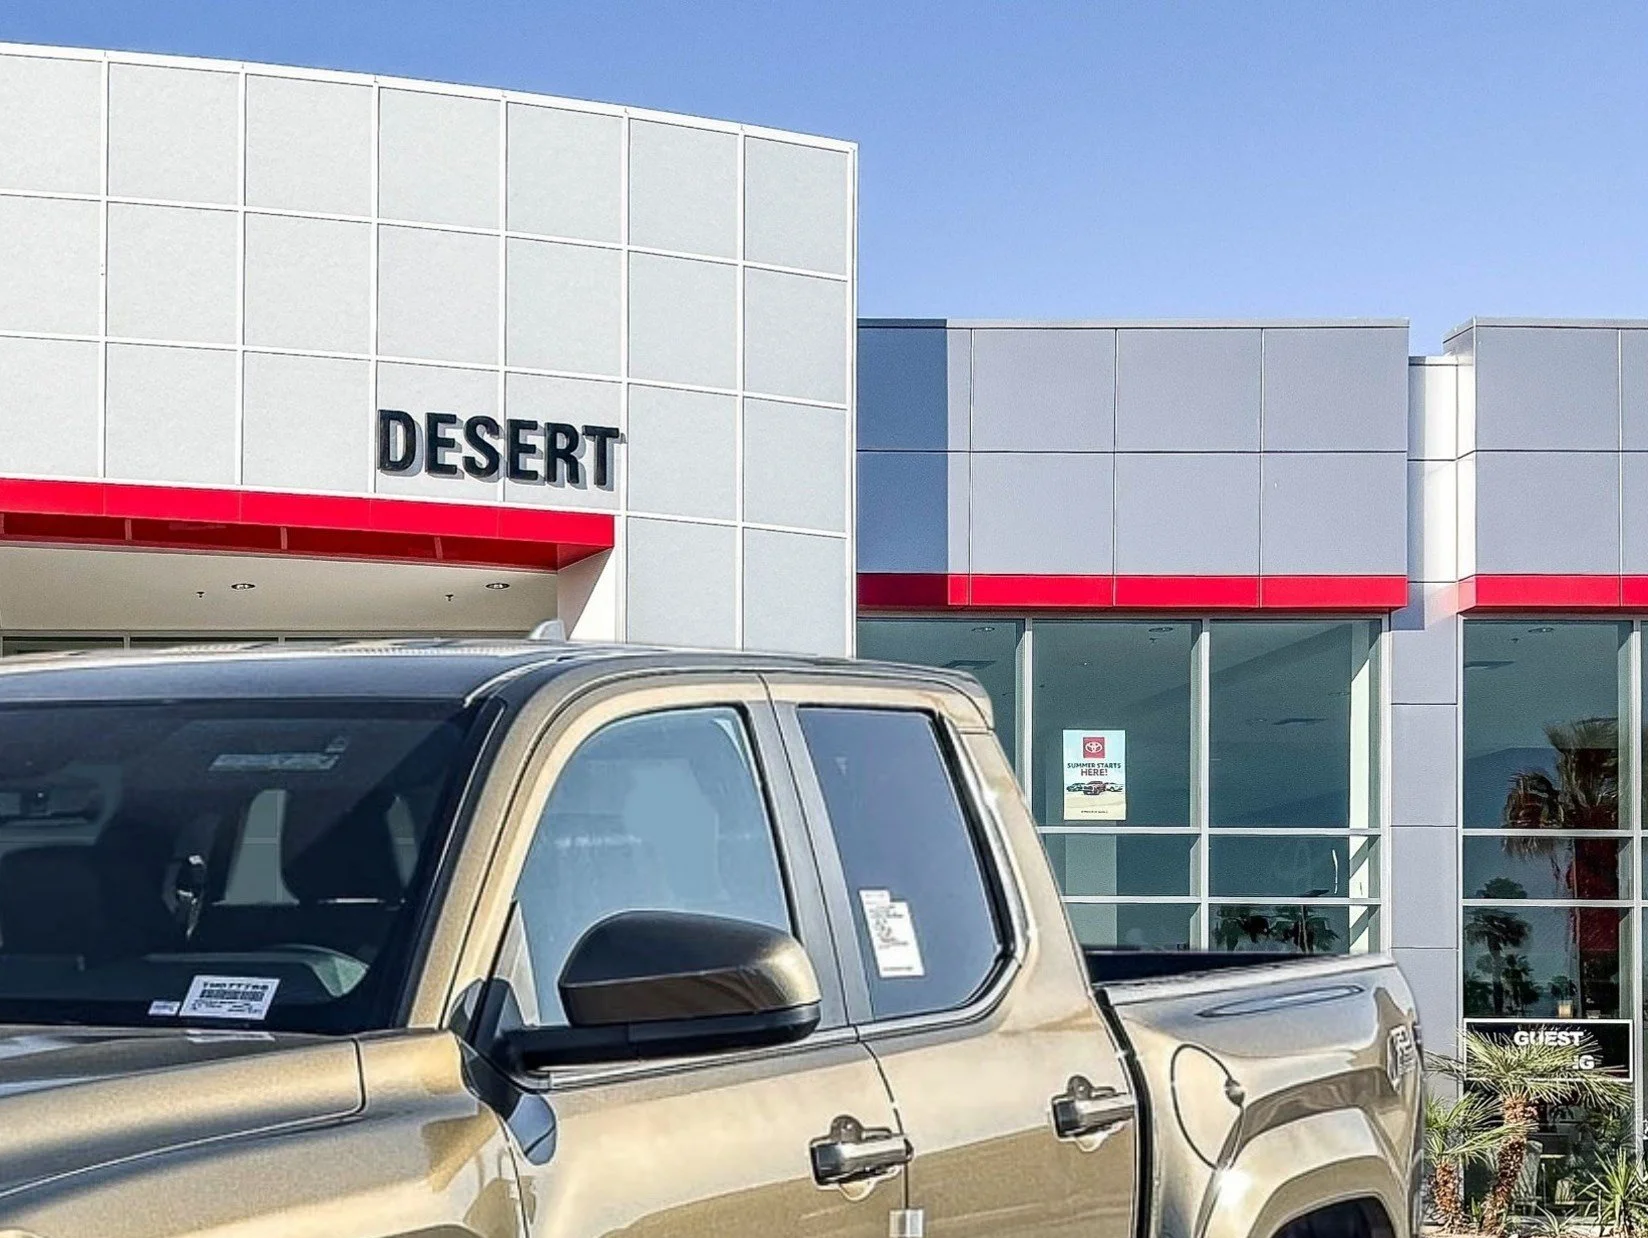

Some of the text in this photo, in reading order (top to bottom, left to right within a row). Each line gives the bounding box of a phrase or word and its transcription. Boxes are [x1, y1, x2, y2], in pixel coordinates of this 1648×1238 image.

[377, 409, 621, 487] DESERT
[1080, 768, 1108, 776] HERE!
[1513, 1030, 1585, 1047] GUEST
